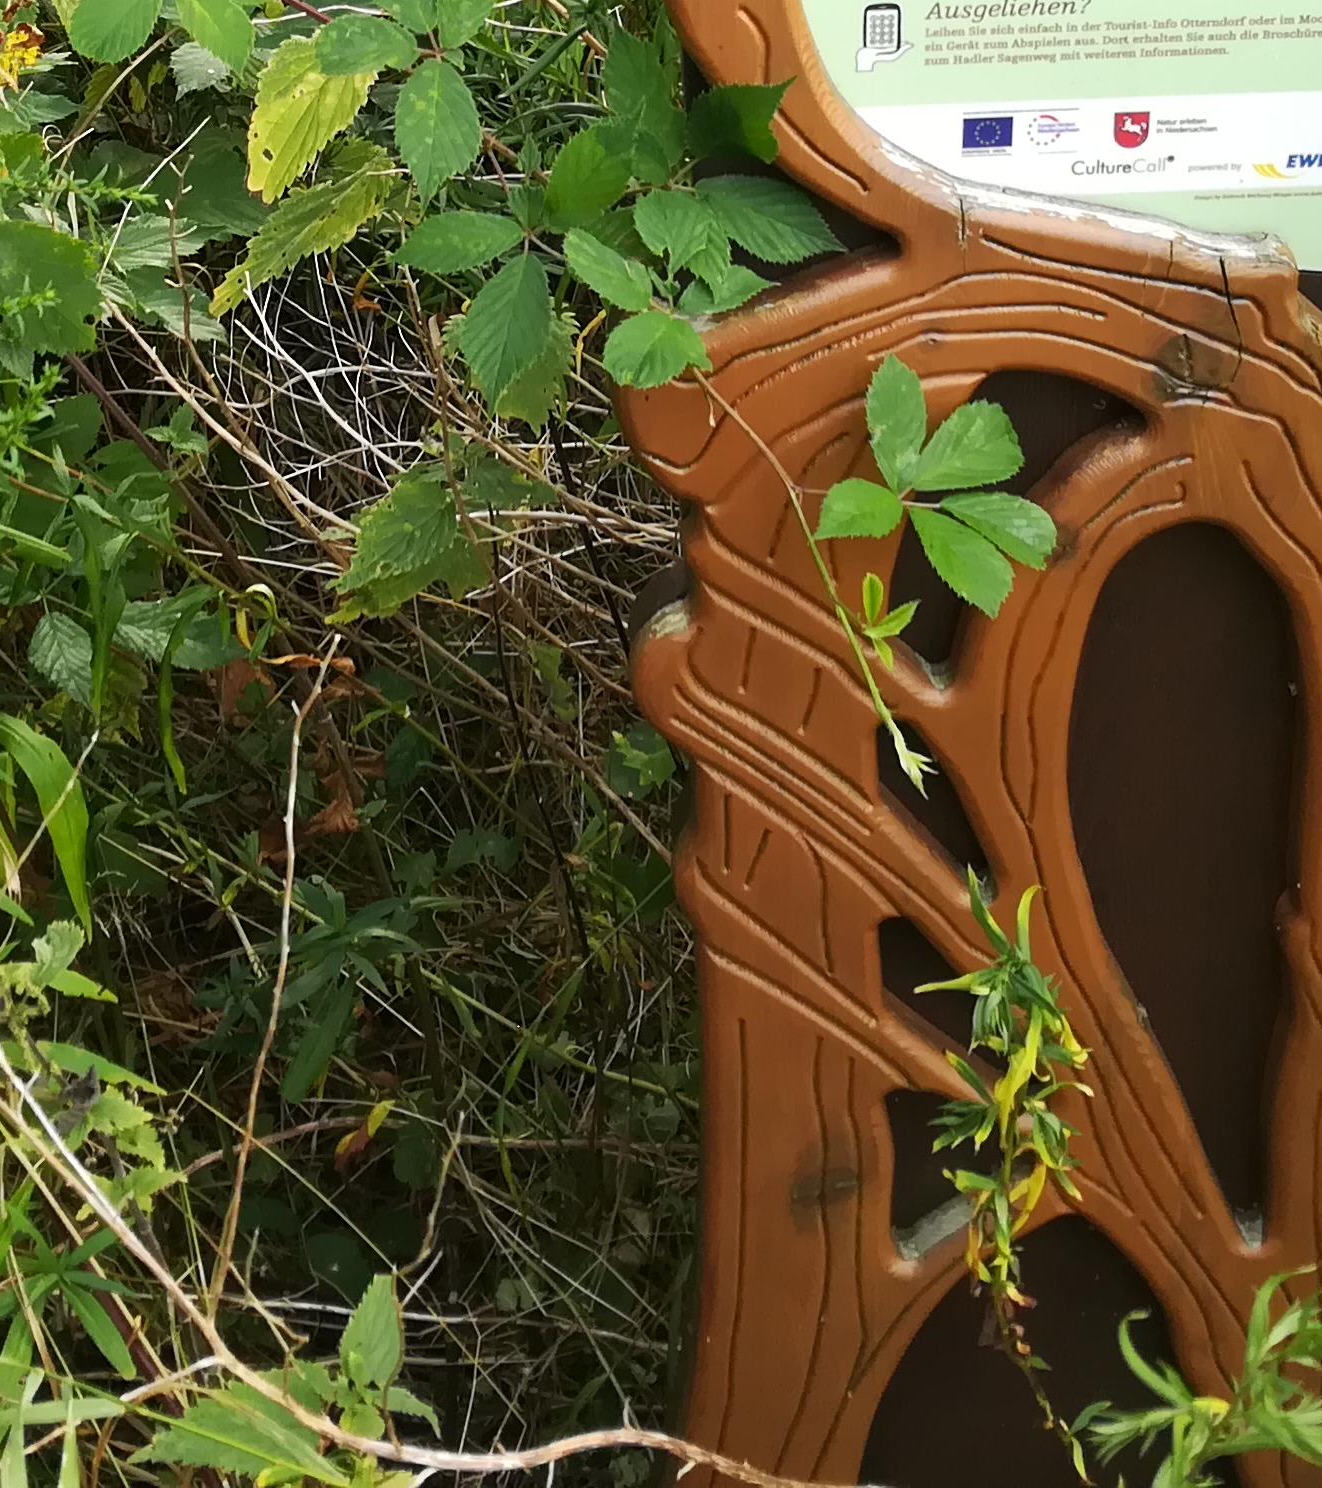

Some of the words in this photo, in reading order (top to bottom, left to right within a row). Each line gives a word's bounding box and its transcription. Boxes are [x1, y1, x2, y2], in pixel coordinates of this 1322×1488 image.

[925, 26, 965, 38] Leihen
[968, 25, 987, 36] Sie
[990, 24, 1015, 35] sich
[1018, 23, 1063, 34] einfach
[1066, 22, 1079, 33] in
[1081, 21, 1102, 32] der
[1103, 18, 1178, 32] Tourist-Info
[1180, 17, 1247, 29] Otterndorf
[1248, 15, 1277, 27] oder
[1279, 14, 1295, 25] im
[924, 40, 943, 52] ein
[946, 39, 980, 51] Gerät
[983, 40, 1008, 50] zum
[1011, 37, 1071, 50] Abspielen
[1074, 37, 1099, 46] aus.
[1102, 35, 1129, 45] Dort
[1132, 32, 1183, 44] erhalten
[1185, 31, 1205, 42] Sie
[1207, 30, 1237, 41] auch
[1239, 29, 1259, 40] die
[924, 56, 950, 66] zum
[953, 53, 995, 65] Hadler
[997, 51, 1057, 65] Sagenweg
[1059, 49, 1082, 61] mit
[1084, 48, 1136, 60] weiteren
[1139, 45, 1230, 58] Informationen.
[1071, 157, 1166, 176] CultureCall
[1187, 163, 1228, 173] powered
[1230, 163, 1243, 173] by
